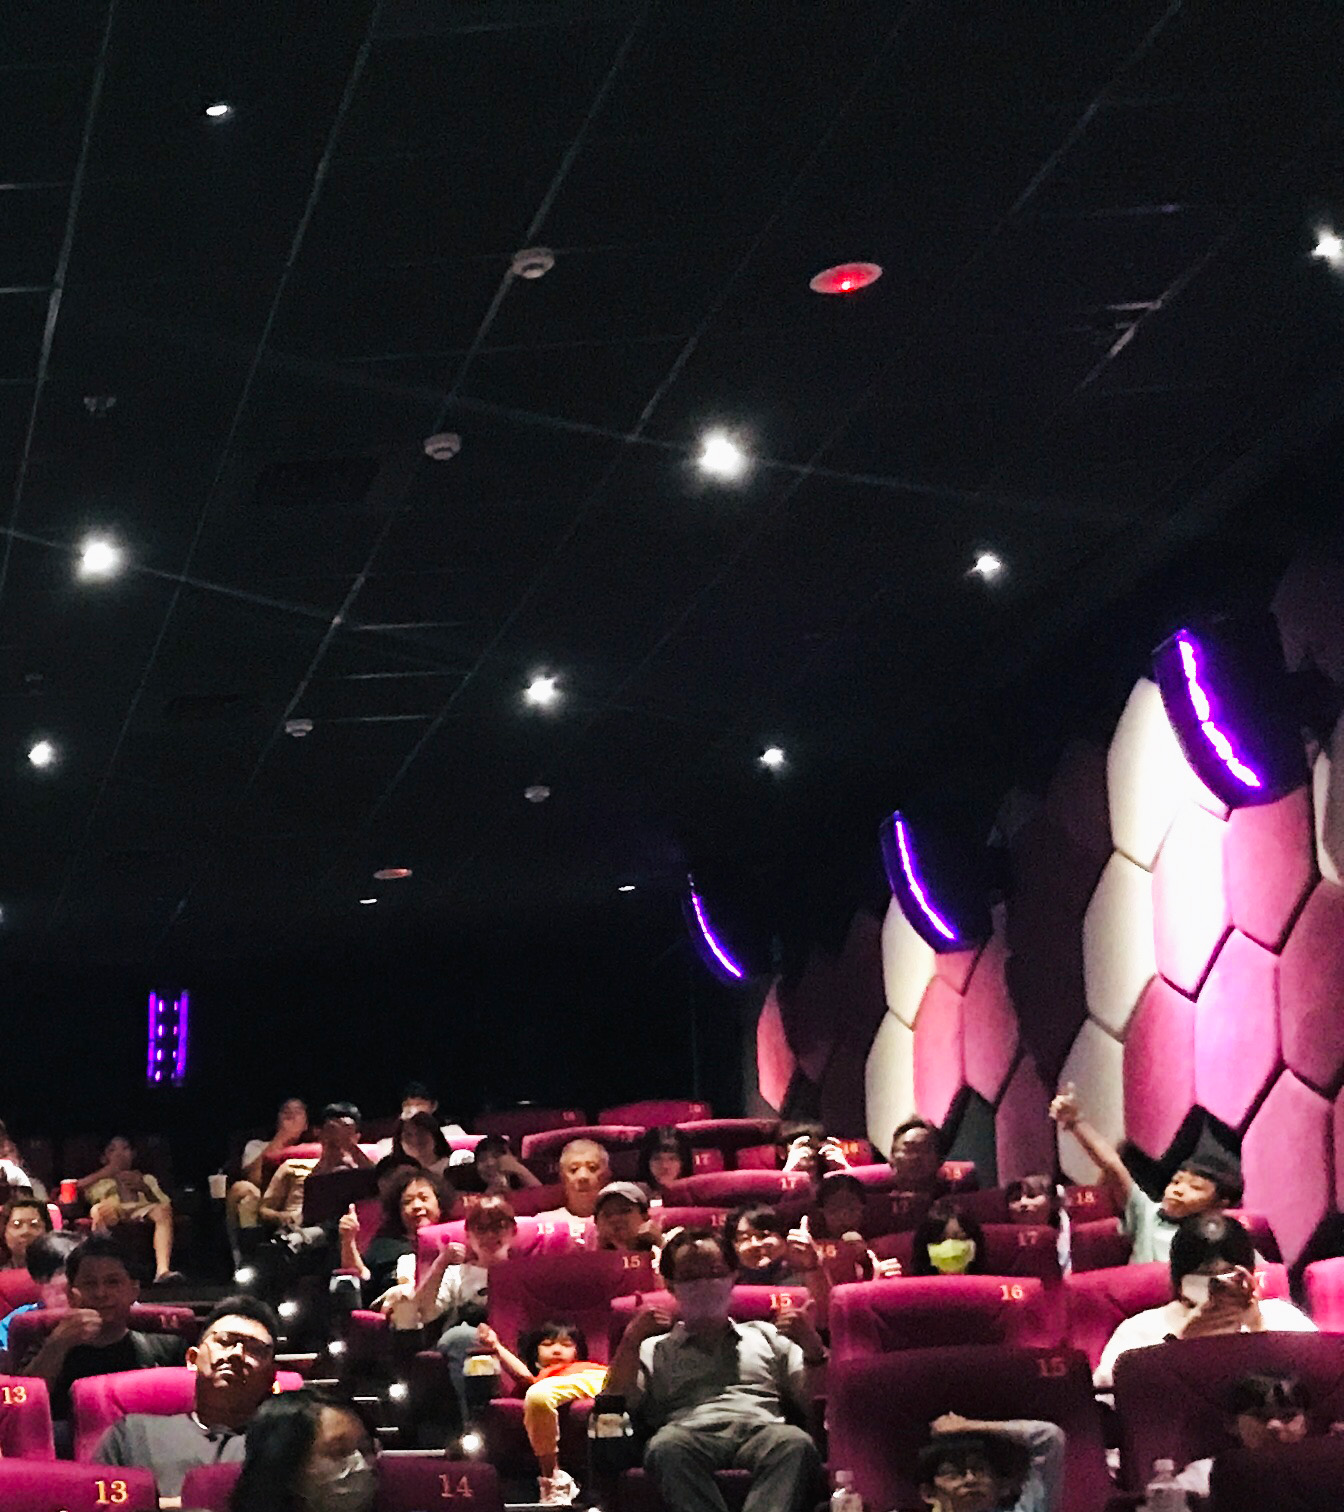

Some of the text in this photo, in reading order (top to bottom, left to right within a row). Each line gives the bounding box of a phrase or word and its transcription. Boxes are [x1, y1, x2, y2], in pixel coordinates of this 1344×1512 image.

[780, 1175, 798, 1190] 17
[536, 1220, 554, 1234] 15
[1018, 1230, 1038, 1246] 17
[622, 1254, 641, 1268] 15
[768, 1293, 791, 1308] 15
[998, 1284, 1024, 1301] 16
[2, 1385, 28, 1405] 13
[95, 1480, 129, 1503] 13
[439, 1474, 475, 1498] 14
